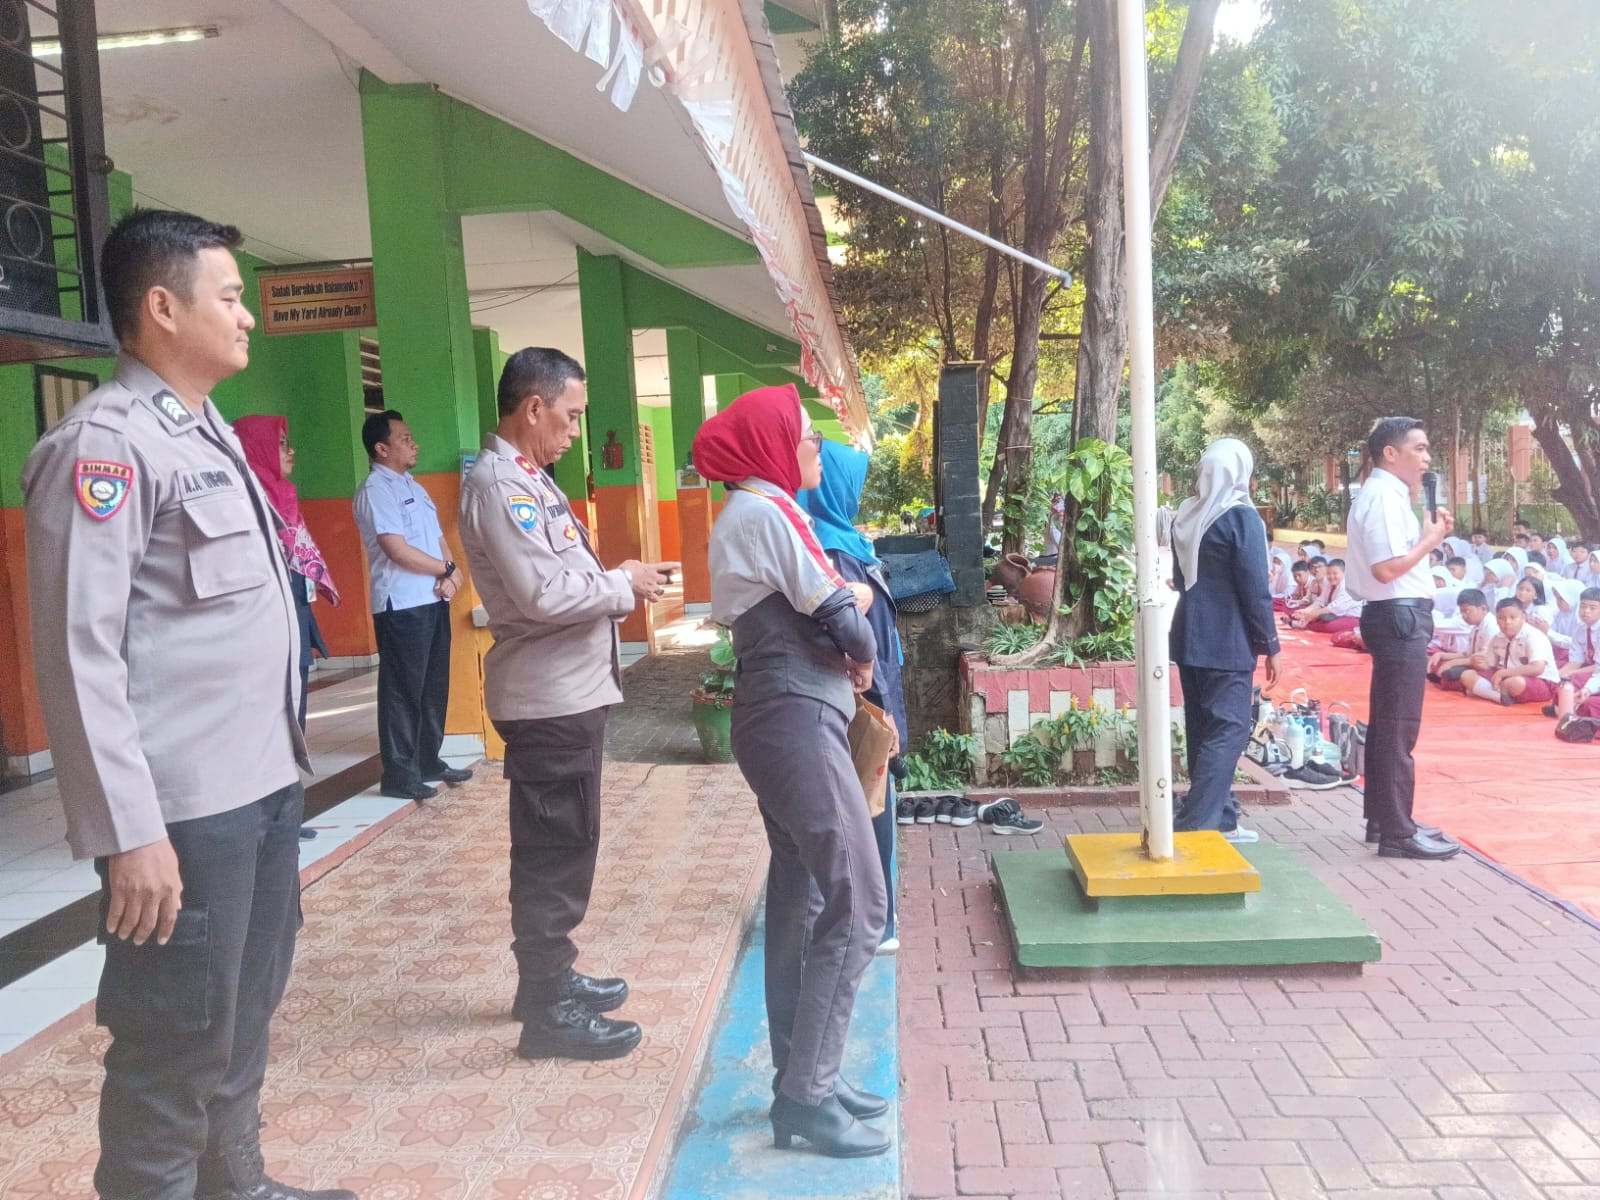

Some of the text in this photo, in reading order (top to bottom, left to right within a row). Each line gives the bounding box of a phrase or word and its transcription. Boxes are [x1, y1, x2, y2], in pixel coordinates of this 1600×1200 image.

[290, 309, 300, 322] My
[302, 307, 317, 320] Yard
[319, 306, 343, 320] Already
[344, 304, 361, 317] Clean
[82, 463, 128, 478] BINMAS
